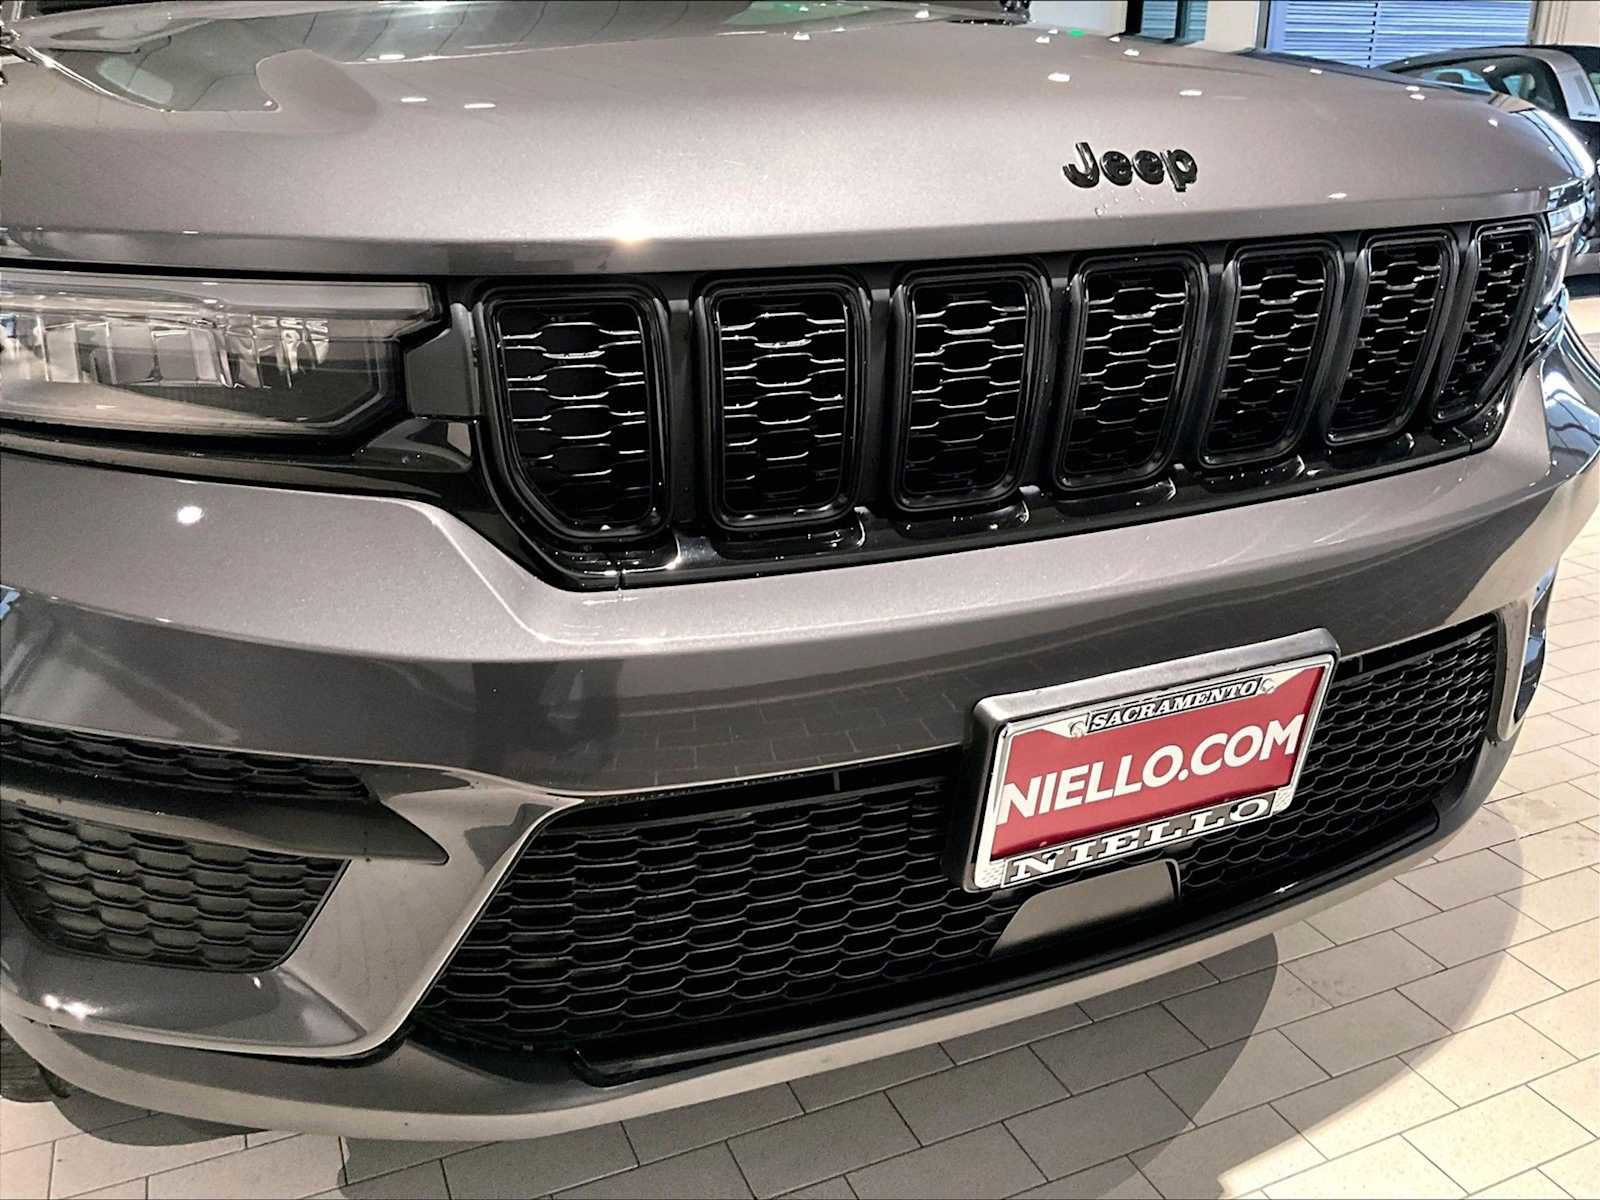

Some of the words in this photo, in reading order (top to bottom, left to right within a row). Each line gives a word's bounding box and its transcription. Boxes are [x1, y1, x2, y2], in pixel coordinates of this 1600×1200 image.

[1062, 142, 1198, 192] Jeep
[1092, 680, 1256, 731] SACRAMENTO
[997, 714, 1304, 825] NIELLO.COM
[1010, 799, 1268, 881] NIELLO
